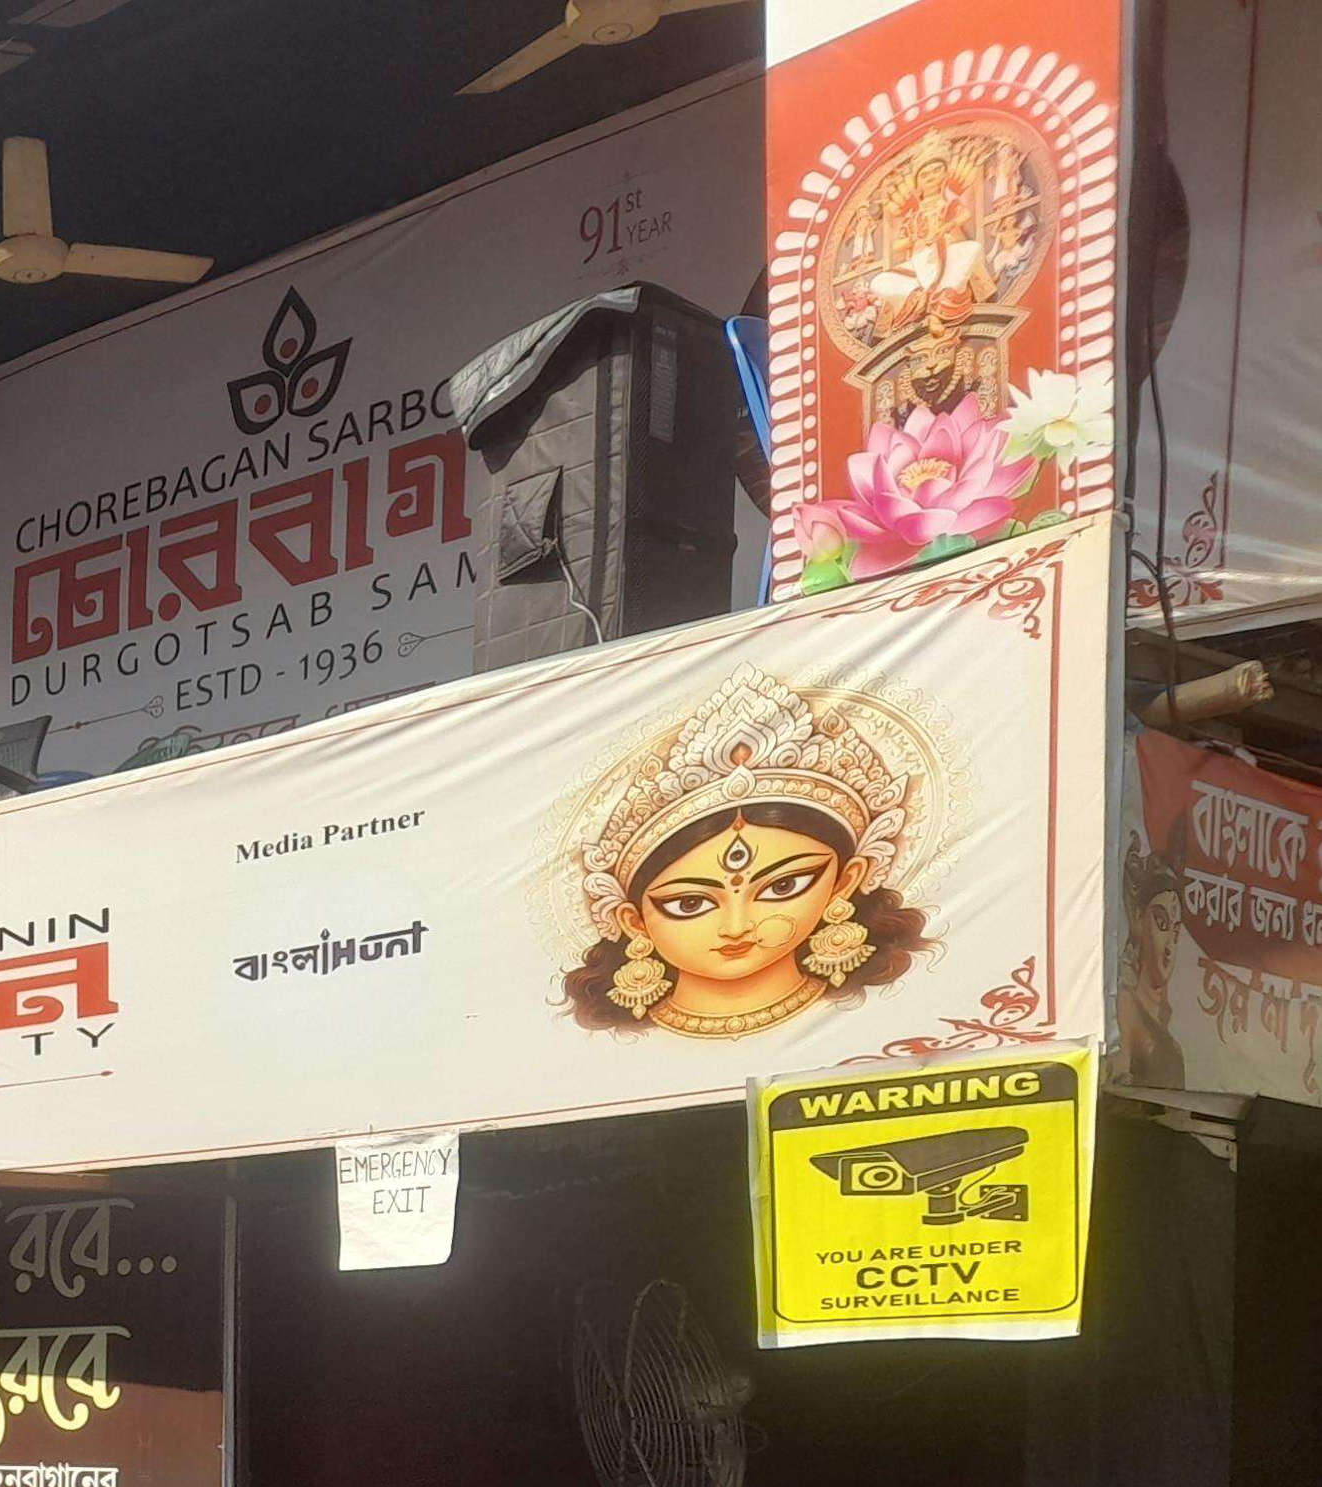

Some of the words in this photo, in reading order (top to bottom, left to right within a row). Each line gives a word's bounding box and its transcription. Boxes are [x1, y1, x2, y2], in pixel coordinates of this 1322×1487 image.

[623, 208, 673, 246] YEAR
[15, 431, 292, 554] CHOREBAGAN
[305, 378, 453, 463] SARBO
[11, 591, 333, 706] DURGOTSAB
[175, 662, 262, 713] ESTD
[297, 630, 384, 687] 1936
[234, 833, 314, 863] Media
[322, 808, 427, 847] Partner
[1191, 779, 1310, 882] বাংলাকে
[1184, 867, 1245, 933] করার
[1250, 885, 1297, 942] জন্য
[1261, 972, 1293, 1054] মা
[799, 1071, 1041, 1121] WARNING
[339, 1148, 453, 1184] EMERGENCY
[372, 1185, 431, 1215] EXIT
[816, 1249, 865, 1267] YOU
[869, 1245, 923, 1261] ARE
[928, 1239, 1022, 1259] UNDER
[855, 1261, 981, 1290] CCTV
[820, 1287, 1021, 1311] SURVEILLANCE
